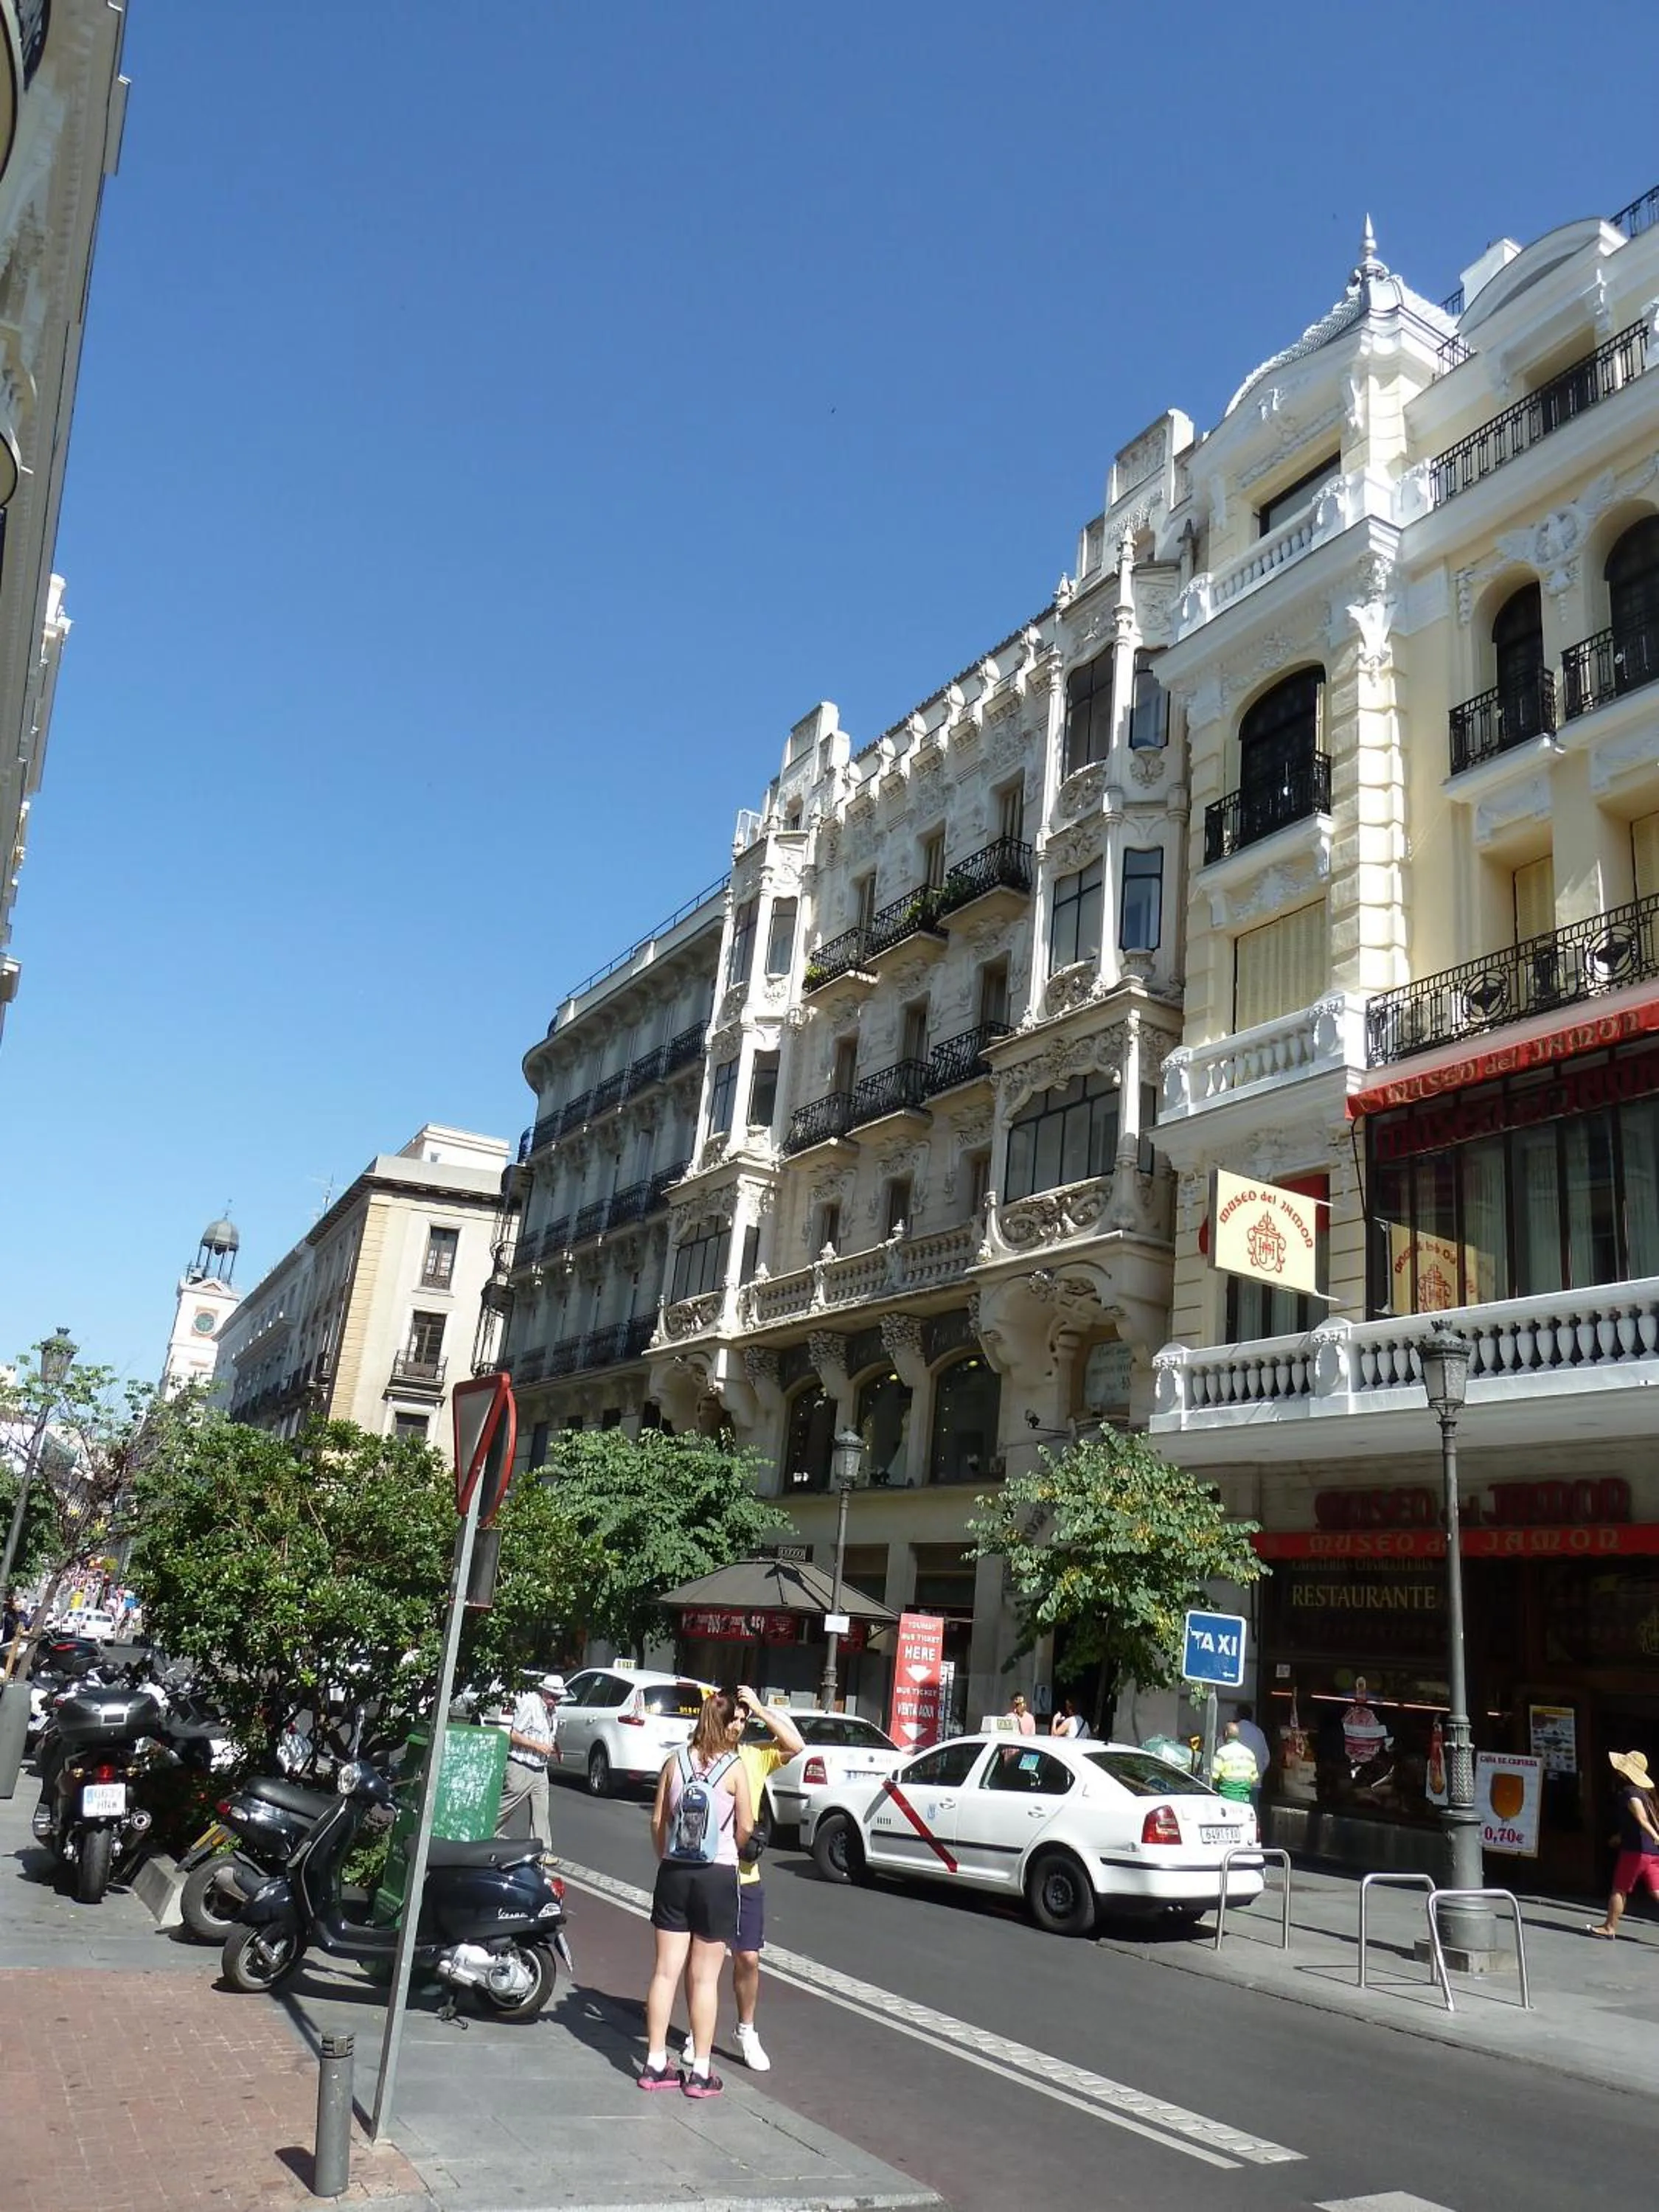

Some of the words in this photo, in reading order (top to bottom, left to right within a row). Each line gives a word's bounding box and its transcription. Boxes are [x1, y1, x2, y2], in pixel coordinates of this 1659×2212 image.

[1219, 1189, 1257, 1225] MUSEO
[1310, 1533, 1414, 1554] MUSEO
[1292, 1585, 1436, 1610] RESTAURANTE
[905, 1645, 936, 1661] HERE
[1190, 1630, 1238, 1657] TAXI
[1484, 1826, 1525, 1844] 0,70€
